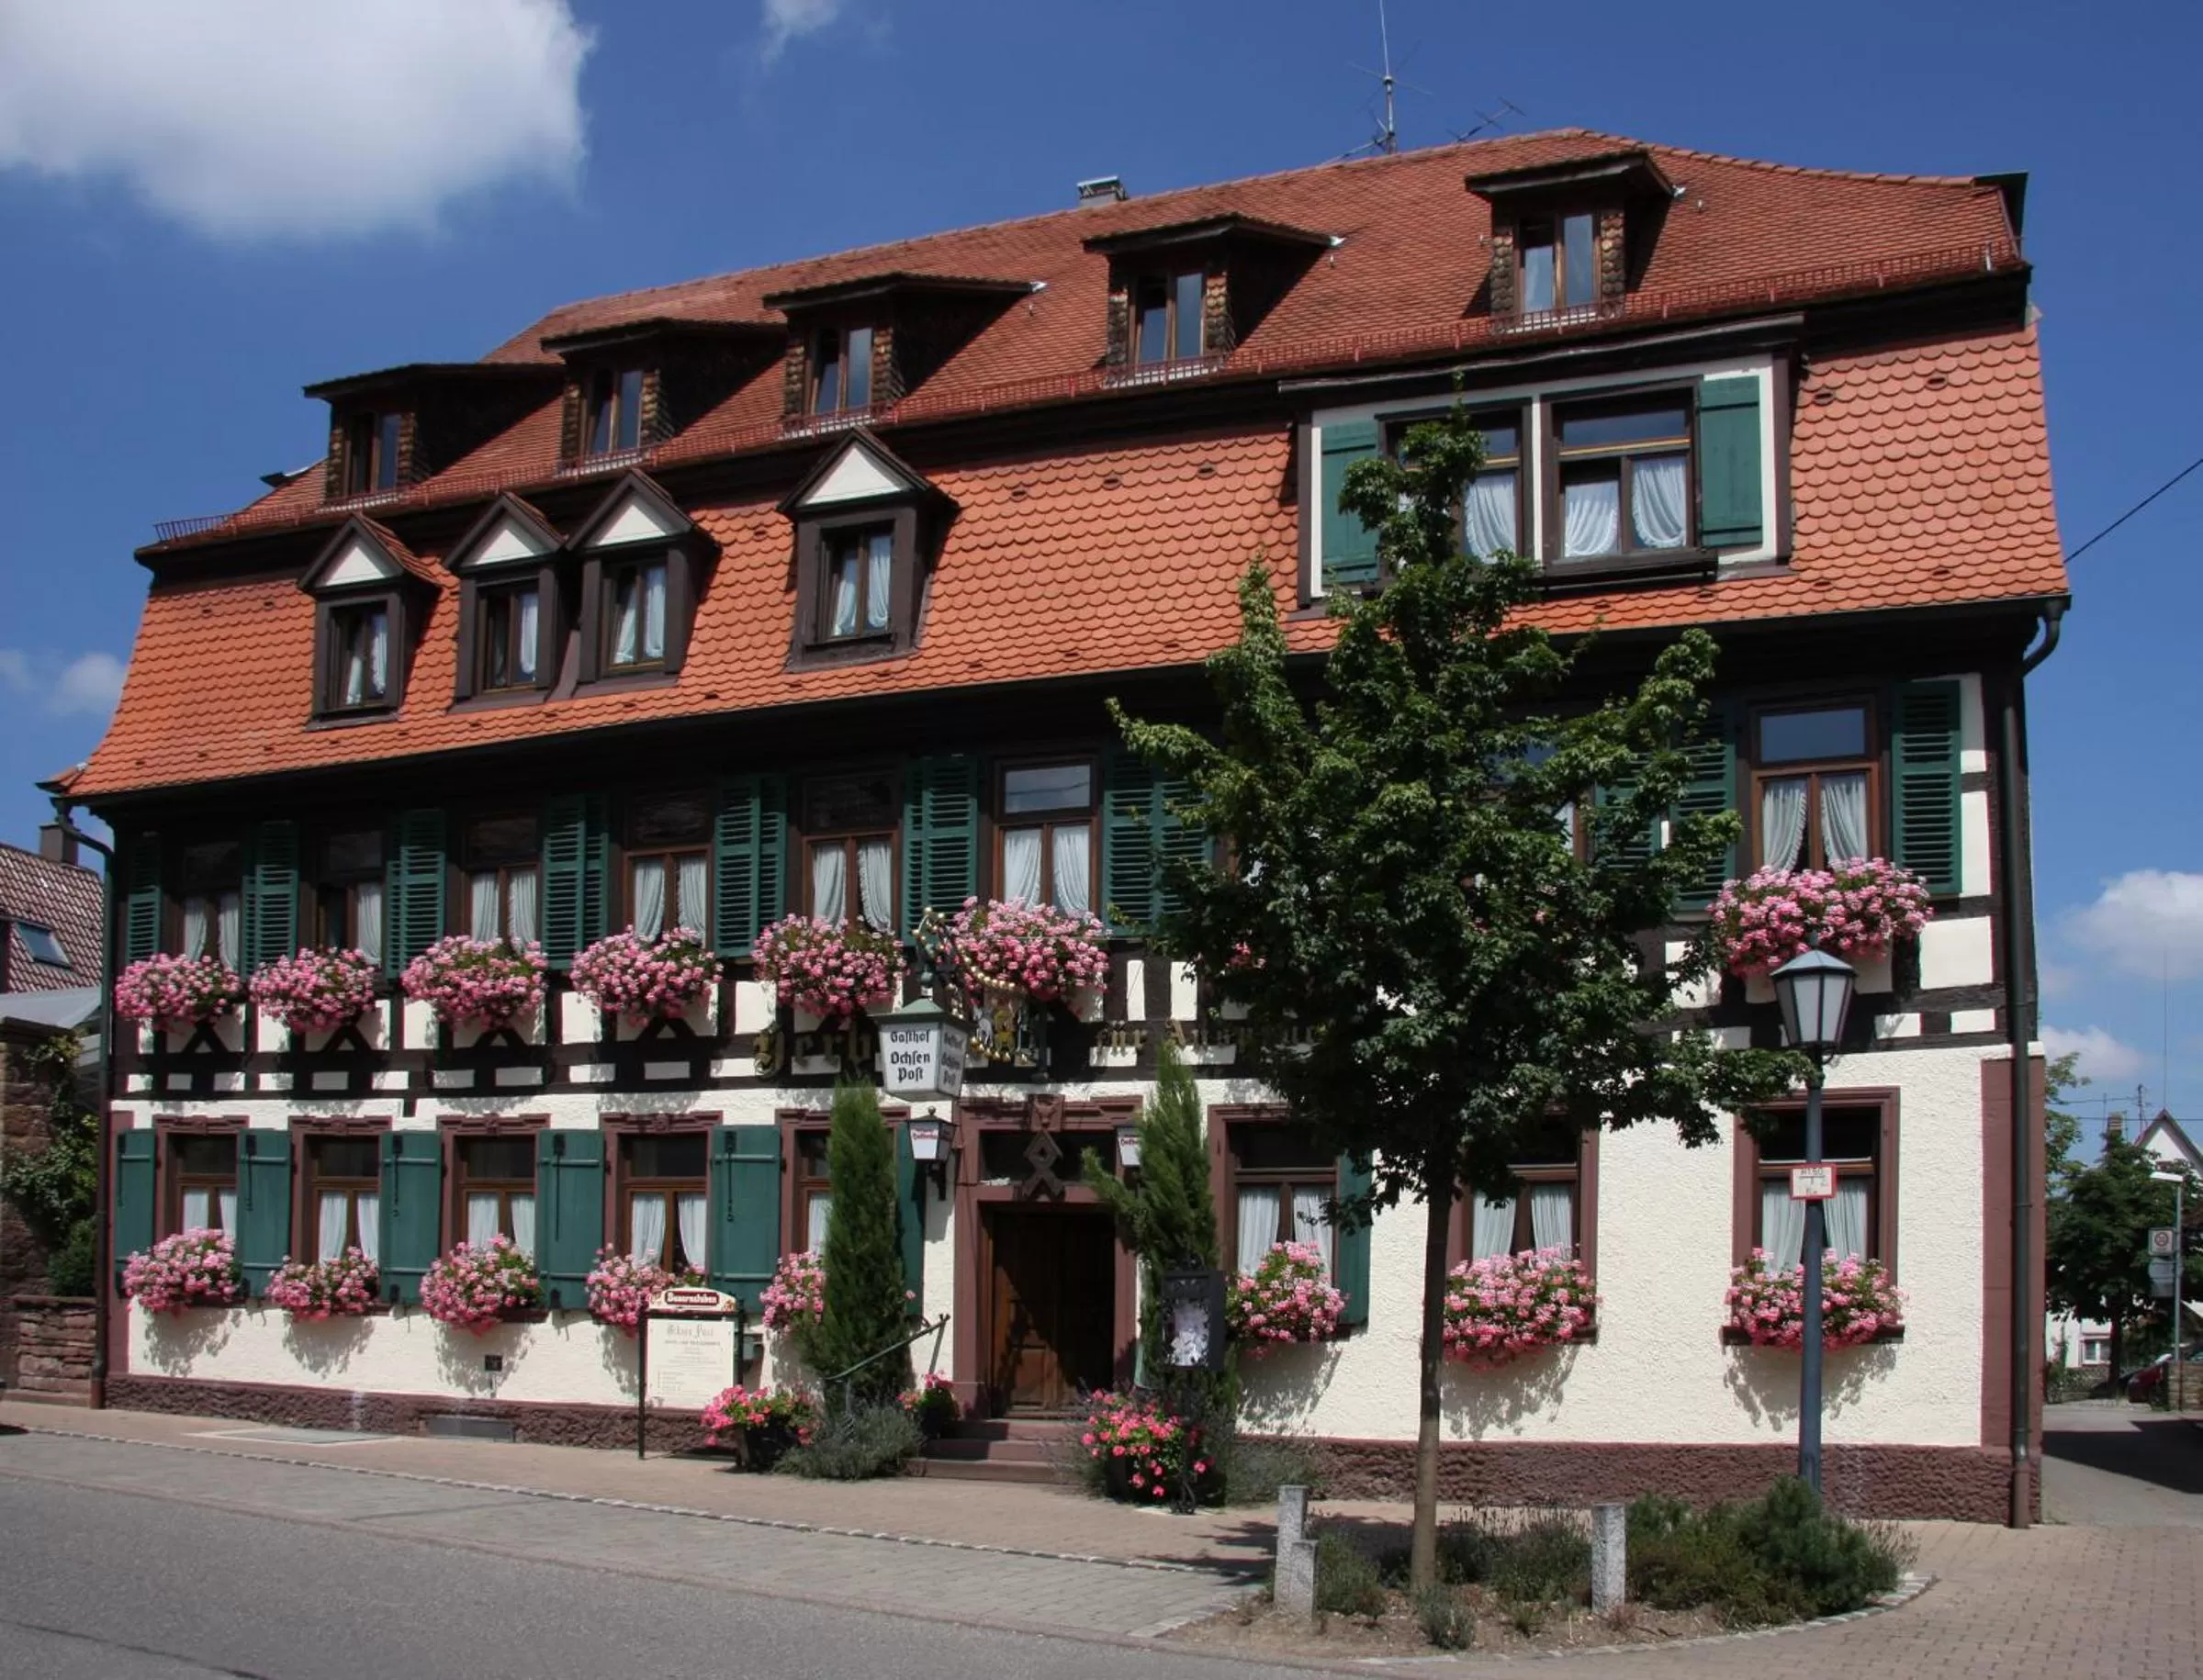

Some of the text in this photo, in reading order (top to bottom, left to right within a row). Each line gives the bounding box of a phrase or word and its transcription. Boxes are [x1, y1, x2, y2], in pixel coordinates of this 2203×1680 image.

[890, 1028, 930, 1044] Gasthof
[890, 1050, 930, 1066] Ochsen
[897, 1067, 924, 1083] Post
